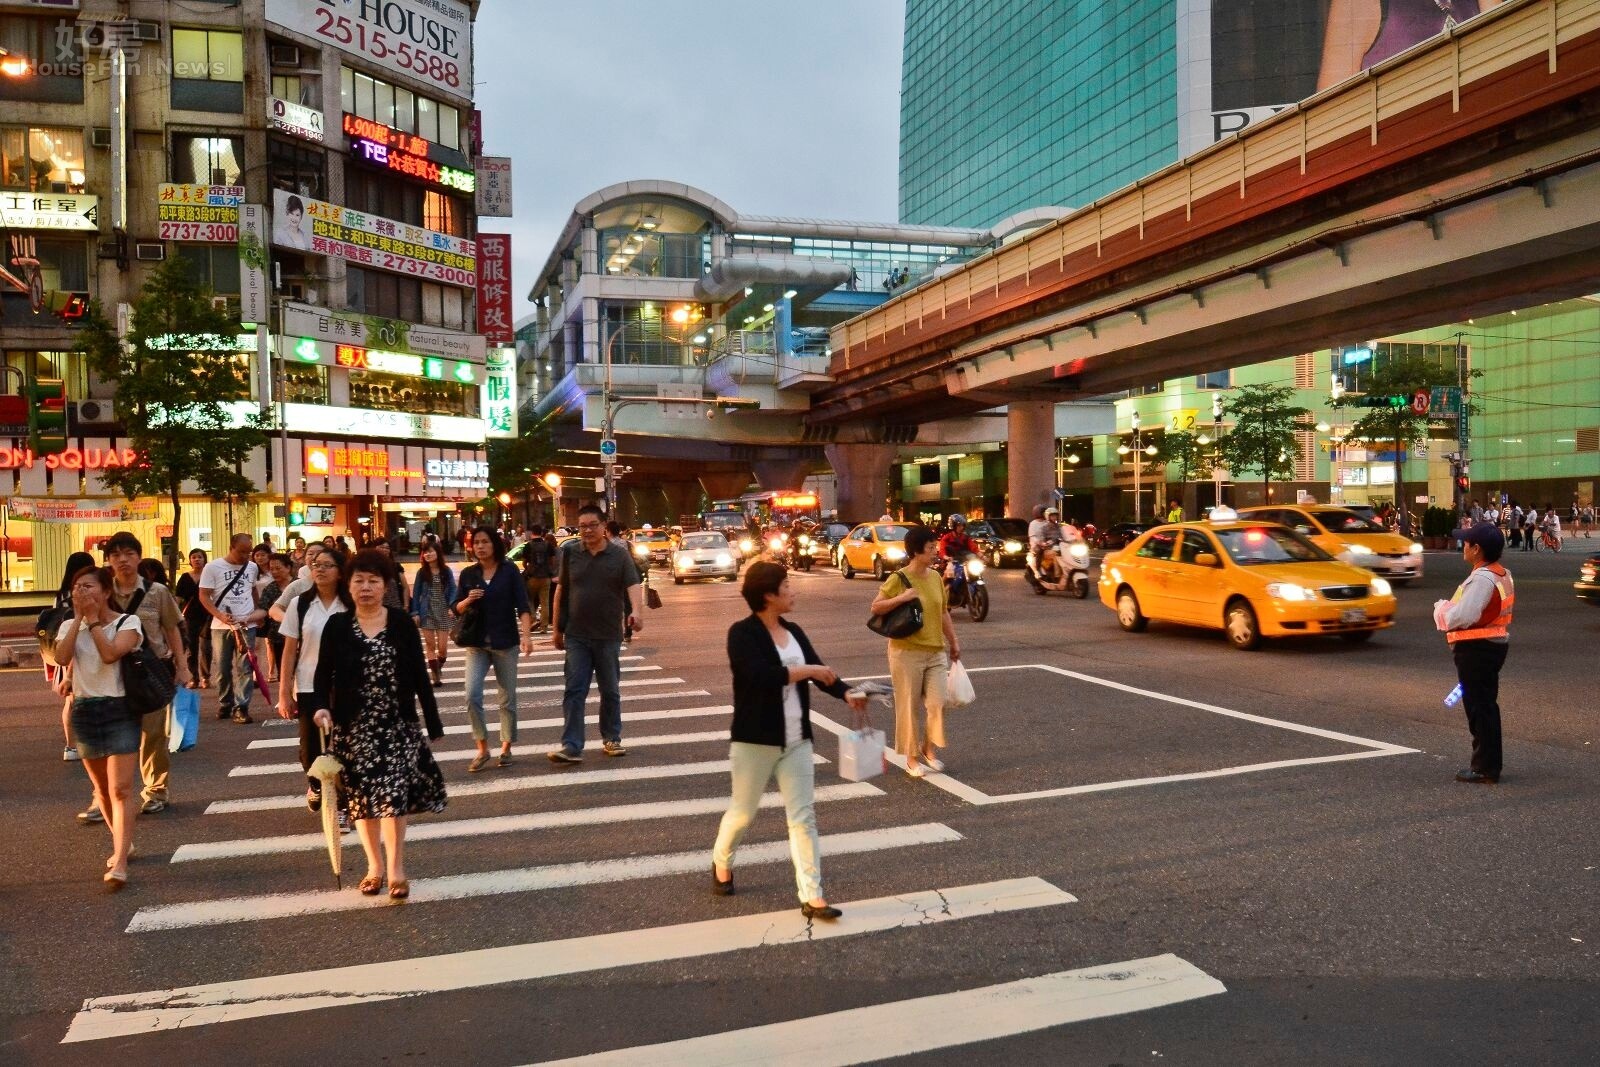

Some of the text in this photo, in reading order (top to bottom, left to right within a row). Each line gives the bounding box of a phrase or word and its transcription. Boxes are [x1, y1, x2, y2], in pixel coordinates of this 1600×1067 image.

[359, 0, 459, 59] HOUSE
[315, 7, 460, 88] 2515-5588
[281, 122, 324, 142] 2731-1949
[209, 187, 244, 196] 命理
[6, 197, 77, 213] 工作室
[208, 196, 242, 206] 風水
[160, 205, 239, 222] 和平東路3段87號6
[161, 223, 239, 240] 2737-300
[249, 292, 258, 320] beauty
[319, 316, 361, 338] 自然美
[411, 335, 471, 351] natural beauty
[488, 375, 512, 432] 假髮
[1186, 416, 1195, 430] 2
[334, 468, 354, 476] LION
[358, 468, 388, 478] TRAVEL
